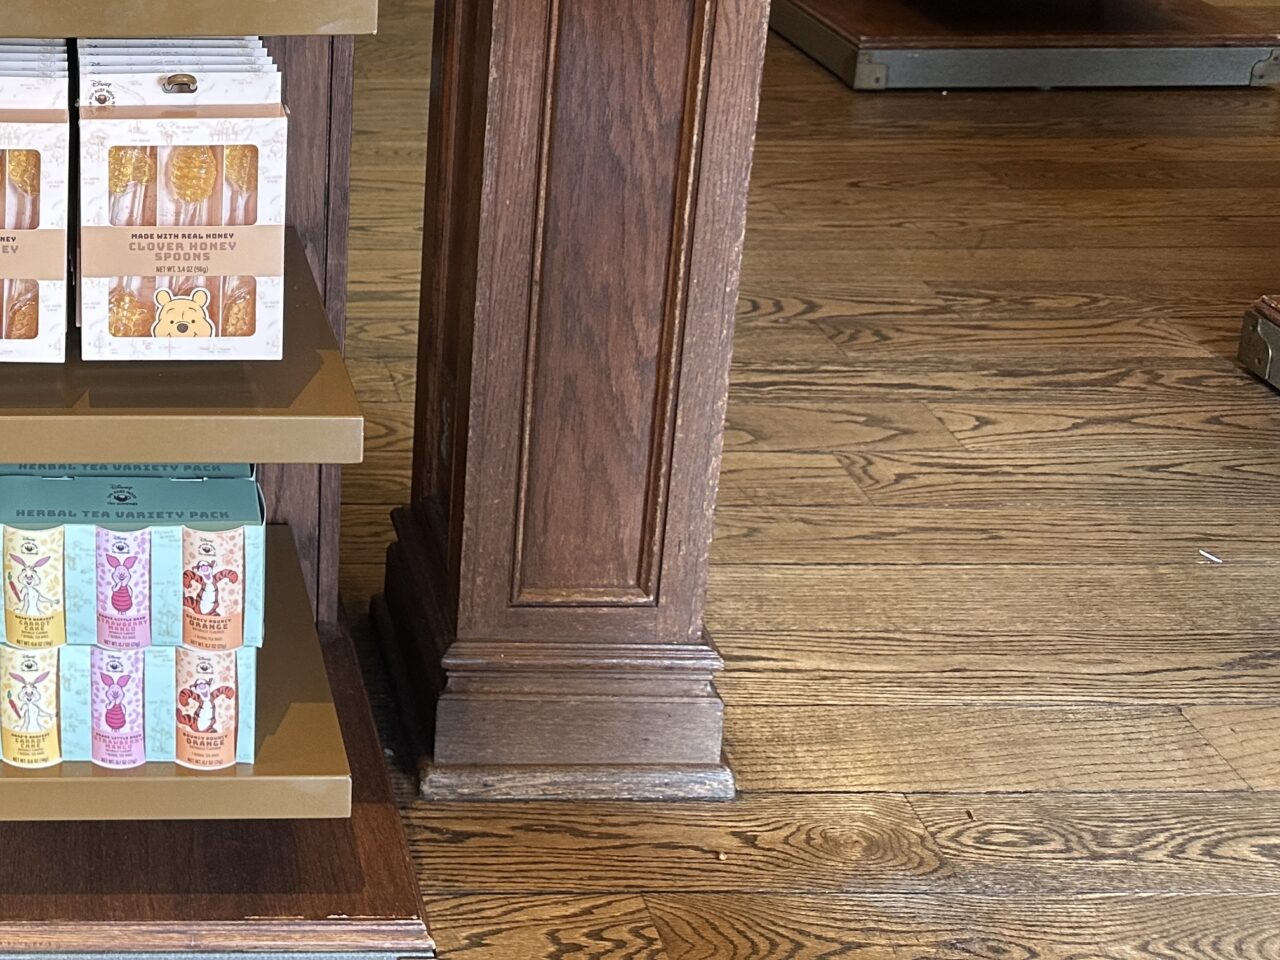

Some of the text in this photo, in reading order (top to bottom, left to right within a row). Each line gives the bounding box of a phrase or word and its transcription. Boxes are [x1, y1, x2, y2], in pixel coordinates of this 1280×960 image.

[129, 242, 236, 251] CLOVER HONEY
[155, 253, 210, 261] SPOONS
[16, 510, 76, 518] HERBAL
[116, 511, 185, 519] VARIETY
